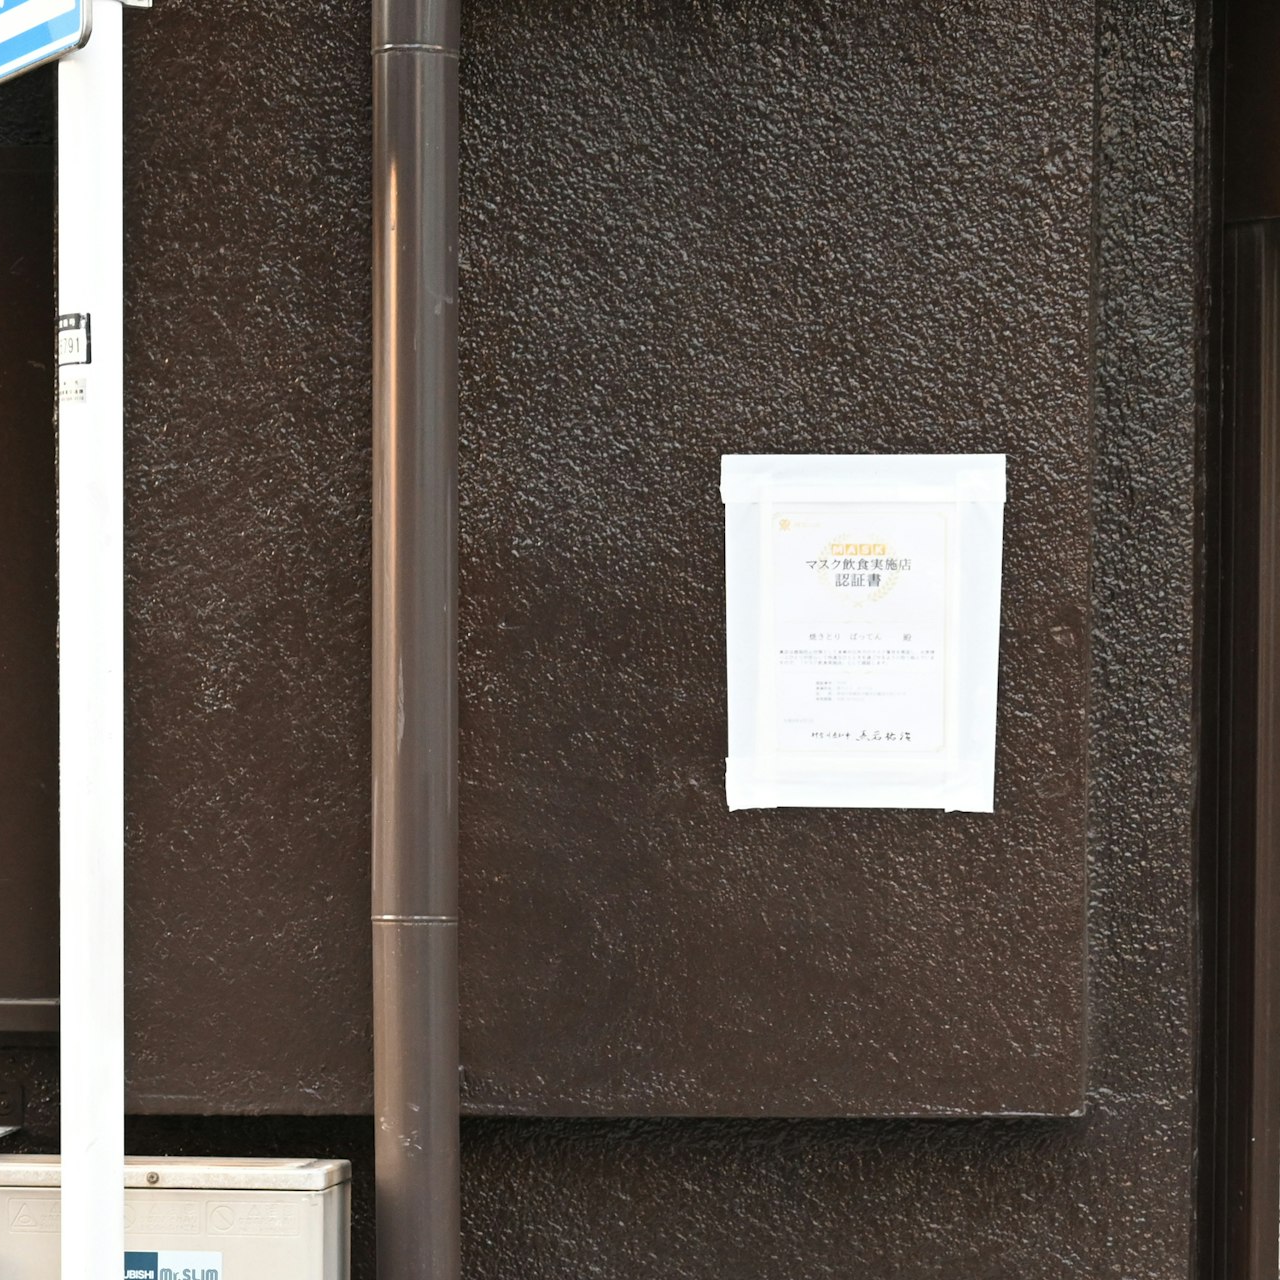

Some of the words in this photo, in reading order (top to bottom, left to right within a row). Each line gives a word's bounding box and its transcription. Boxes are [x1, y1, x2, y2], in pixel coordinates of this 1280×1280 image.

[833, 544, 887, 556] MASK
[806, 558, 912, 571] マスク飲食実施店
[835, 573, 881, 587] 認証書
